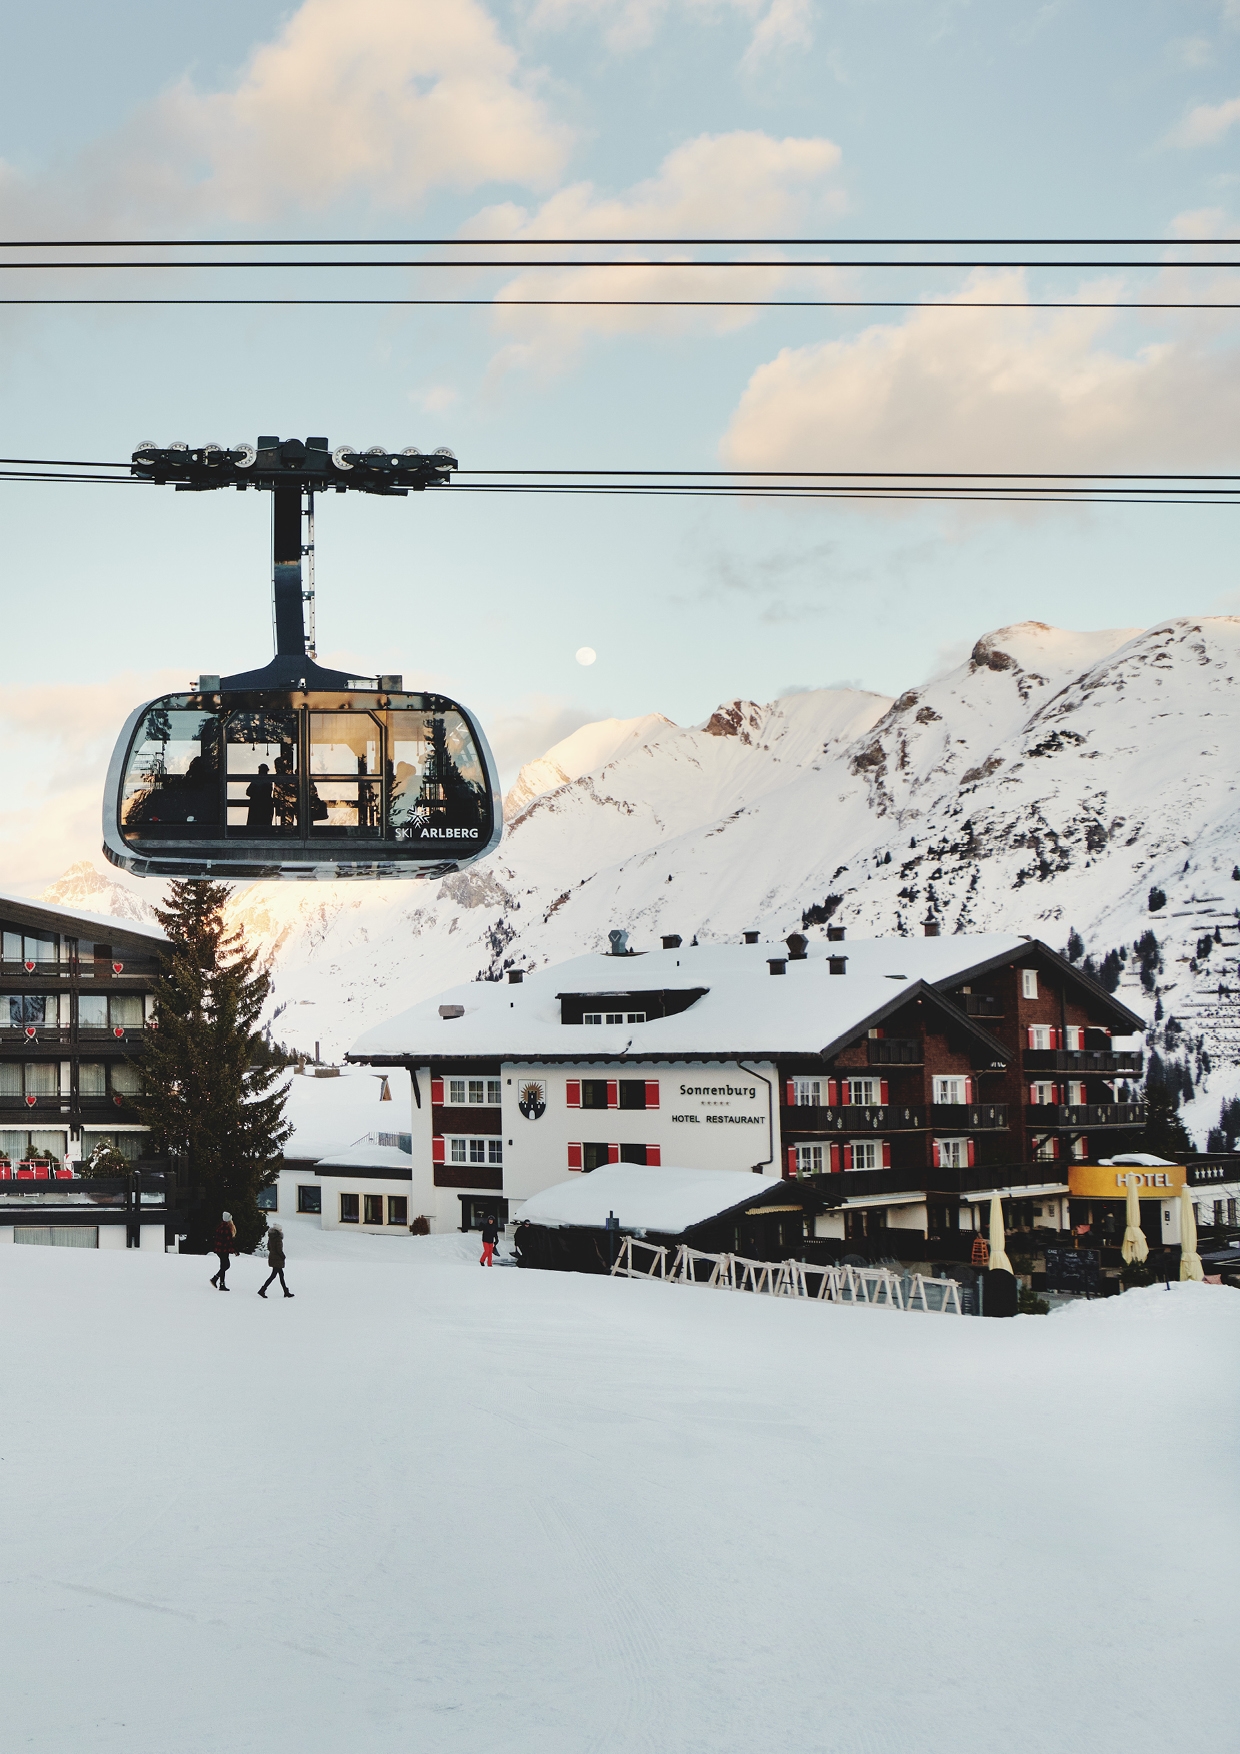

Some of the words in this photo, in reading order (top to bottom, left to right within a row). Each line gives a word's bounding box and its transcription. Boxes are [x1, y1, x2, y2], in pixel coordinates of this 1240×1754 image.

[395, 828, 413, 838] SKI
[420, 828, 479, 838] ARLBERG
[680, 1084, 756, 1098] Sonnenburg
[671, 1115, 700, 1123] HOTEL
[706, 1115, 765, 1124] RESTAURANT
